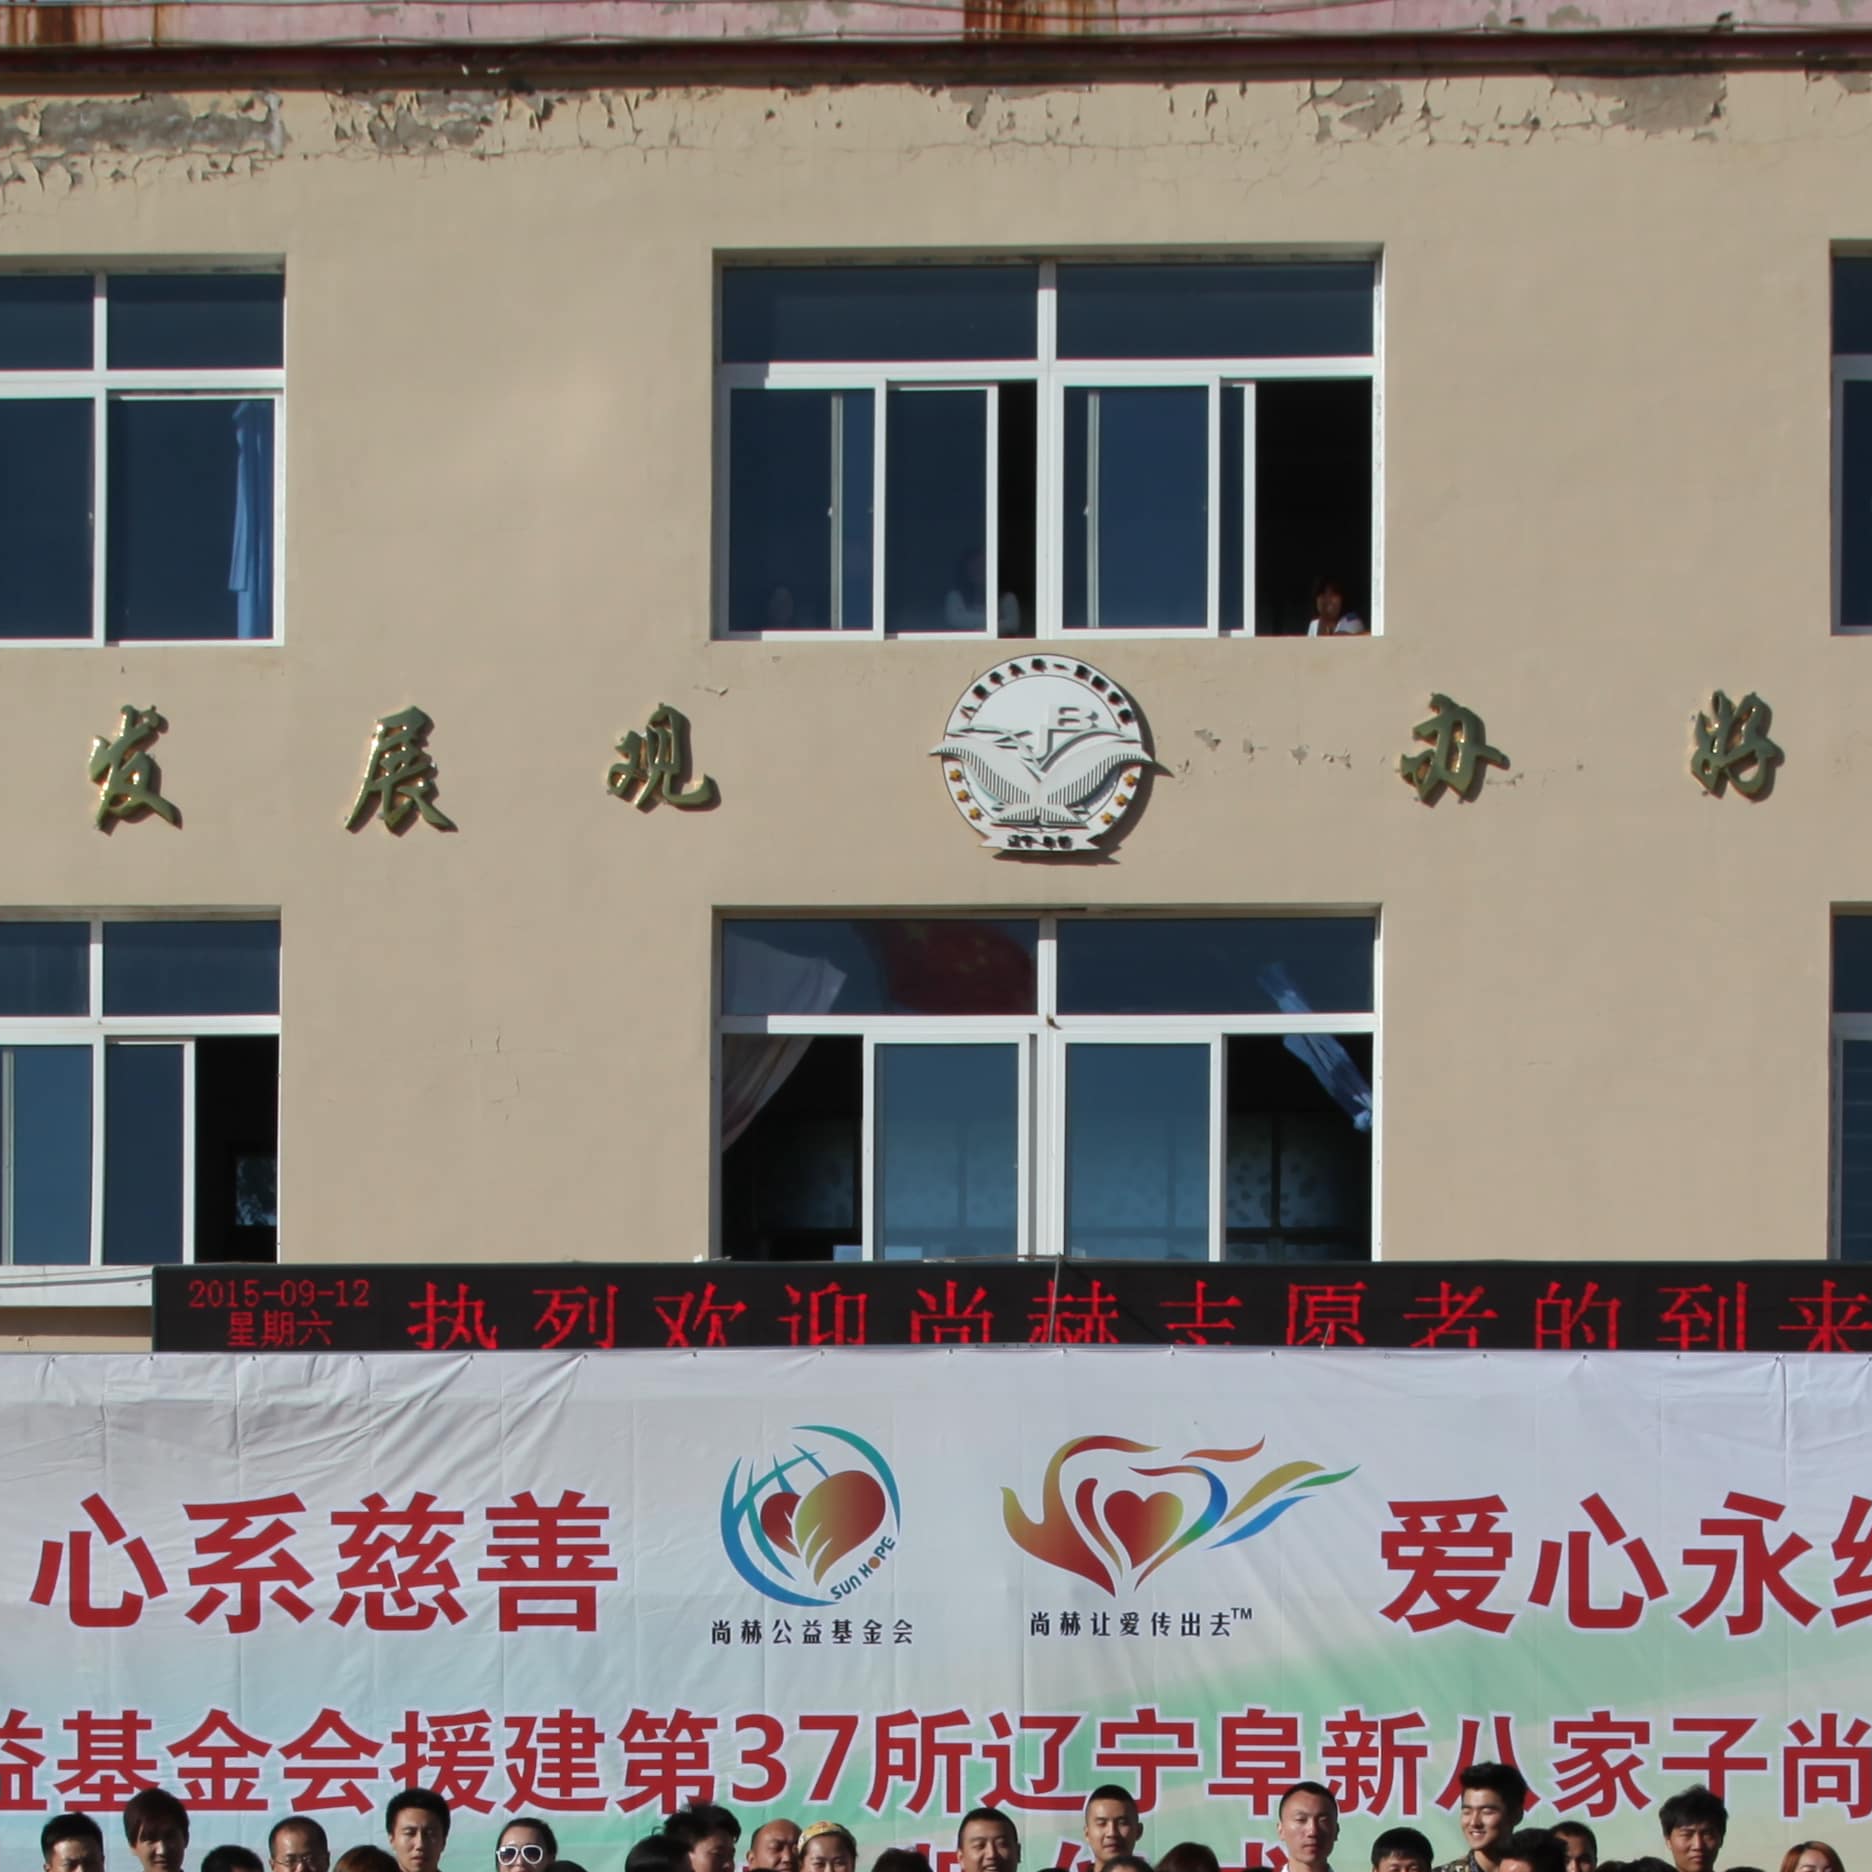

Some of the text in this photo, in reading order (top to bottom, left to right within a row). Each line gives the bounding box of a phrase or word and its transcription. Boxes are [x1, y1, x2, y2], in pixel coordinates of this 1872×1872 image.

[189, 1280, 370, 1308] 2015-09-12
[228, 1311, 334, 1347] 星期六
[31, 1492, 618, 1633] 心系慈善
[711, 1618, 913, 1646] 尚赫公益基金会
